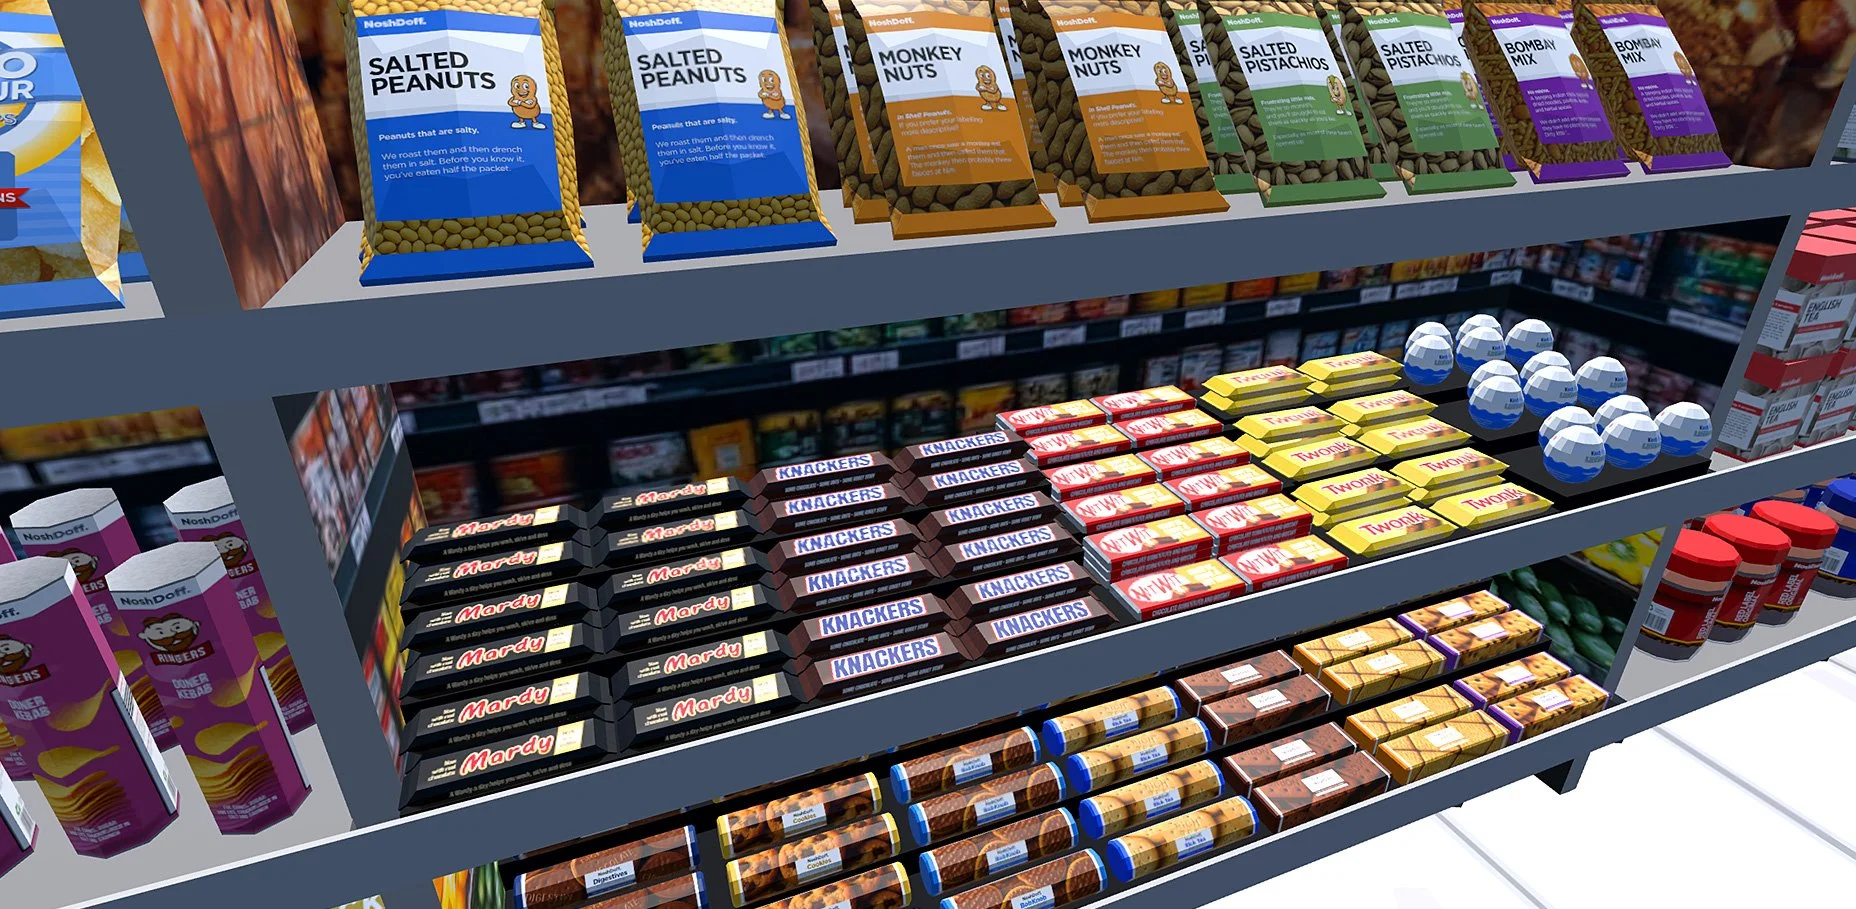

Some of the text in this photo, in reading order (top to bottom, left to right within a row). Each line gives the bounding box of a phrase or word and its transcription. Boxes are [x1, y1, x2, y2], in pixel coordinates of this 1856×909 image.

[878, 46, 962, 66] MONKEY
[1068, 44, 1141, 62] MONKEY
[1239, 41, 1297, 59] SALTED
[1380, 40, 1433, 57] SALTED
[1503, 38, 1557, 55] BOMBAY
[1614, 37, 1662, 53] BOMBAY
[368, 51, 469, 75] SALTED
[637, 48, 722, 71] SALTED
[1245, 56, 1330, 74] PISTACHIOS
[1386, 54, 1462, 70] PISTACHIOS
[1510, 53, 1537, 68] MIX
[1620, 50, 1645, 65] MIX
[641, 67, 747, 89] PEANUTS
[883, 63, 938, 83] NUTS
[1073, 60, 1122, 78] NUTS
[371, 72, 496, 96] PEANUTS
[379, 131, 416, 141] Peanuts
[418, 129, 436, 137] that
[455, 126, 479, 136] salty.
[381, 145, 523, 161] We roast them and then drench
[383, 162, 407, 170] them
[409, 160, 417, 168] in
[419, 158, 437, 167] salt.
[439, 156, 469, 165] Before
[471, 156, 488, 164] you
[490, 155, 513, 163] know
[416, 168, 441, 176] eaten
[443, 166, 460, 174] half
[462, 165, 477, 173] the
[1807, 298, 1842, 314] ENGLISH
[1802, 312, 1820, 323] TEA
[1769, 400, 1798, 416] ENGLISH
[1824, 401, 1837, 411] TEA
[1765, 414, 1780, 424] TEA
[922, 432, 1006, 455] KNACKERS
[1291, 440, 1350, 462] Twonk
[779, 455, 871, 479] KNACKERS
[935, 462, 1021, 487] KNACKERS
[1322, 472, 1386, 495] Twonk
[635, 484, 706, 506] Mardy
[788, 487, 883, 513] KNACKERS
[1462, 487, 1523, 511] Twonk
[948, 495, 1036, 522] KNACKERS
[23, 523, 89, 542] NoshDoff.
[452, 513, 535, 538] Mardy
[641, 518, 715, 543] Mardy
[1359, 511, 1425, 536] Twonk
[797, 523, 893, 553] KNACKERS
[962, 527, 1052, 558] KNACKERS
[453, 551, 538, 578] Mardy
[647, 556, 722, 584] Mardy
[808, 558, 906, 592] KNACKERS
[978, 565, 1070, 599] KNACKERS
[1778, 574, 1800, 605] RED LABEL
[120, 585, 192, 607] NoshDoff.
[1734, 590, 1755, 622] RED LABEL
[454, 593, 541, 624] Mardy
[655, 595, 730, 625] Mardy
[822, 598, 924, 635] KNACKERS
[993, 601, 1089, 638] KNACKERS
[158, 646, 207, 665] RINGERS
[456, 636, 545, 670] Mardy
[664, 642, 742, 674] Mardy
[833, 638, 938, 678] KNACKERS
[171, 673, 210, 691] DONER
[175, 682, 213, 700] KEBAB
[7, 695, 46, 711] DONER
[458, 686, 550, 723] Mardy
[672, 685, 752, 721] Mardy
[13, 707, 51, 722] KEBAB
[460, 734, 554, 776] Mardy
[593, 870, 628, 885] Digestives
